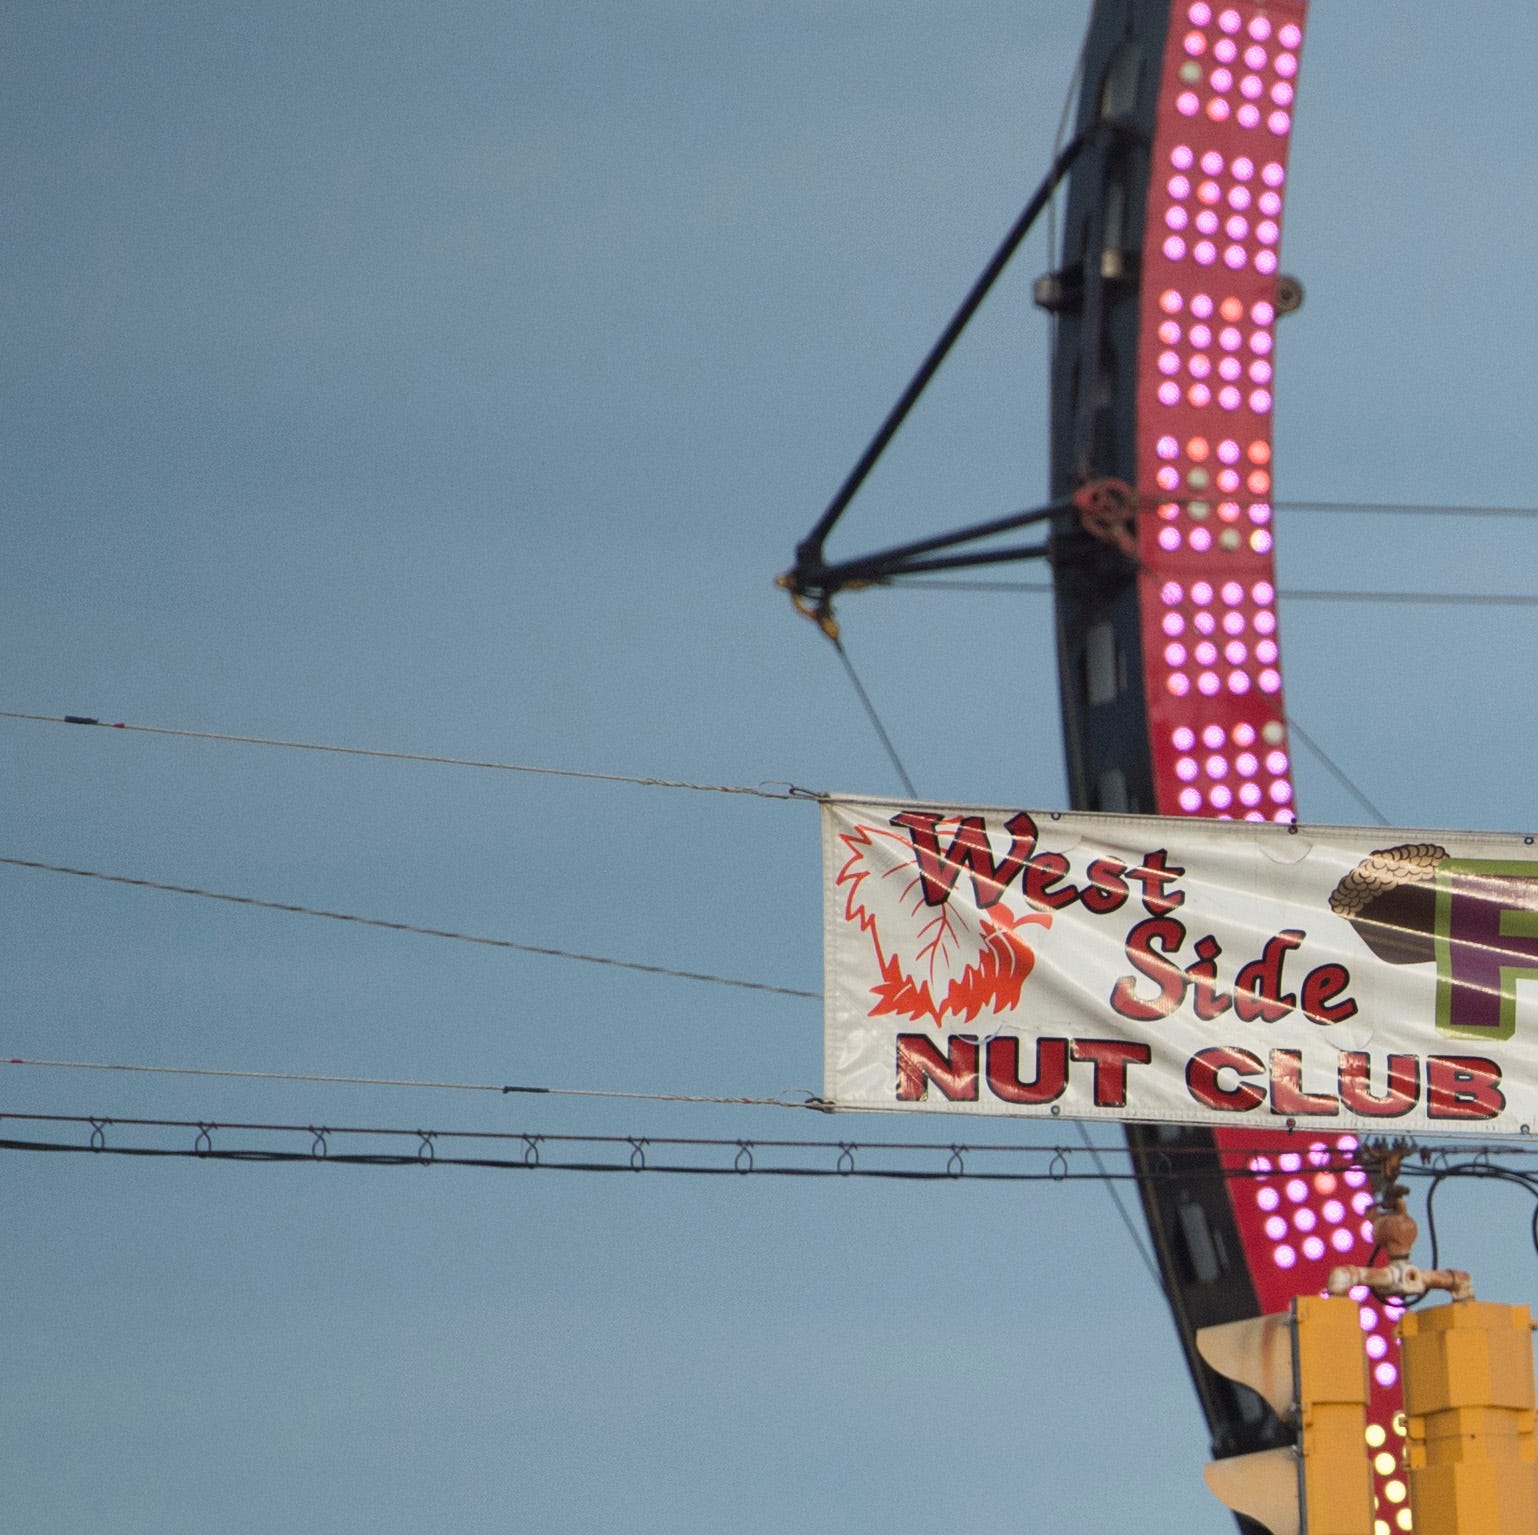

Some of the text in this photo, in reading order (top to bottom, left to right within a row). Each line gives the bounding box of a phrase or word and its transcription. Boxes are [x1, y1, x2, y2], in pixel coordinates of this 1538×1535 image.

[891, 811, 1186, 916] West
[1111, 916, 1358, 1025] Side
[896, 1033, 1507, 1121] NUT CLUB
